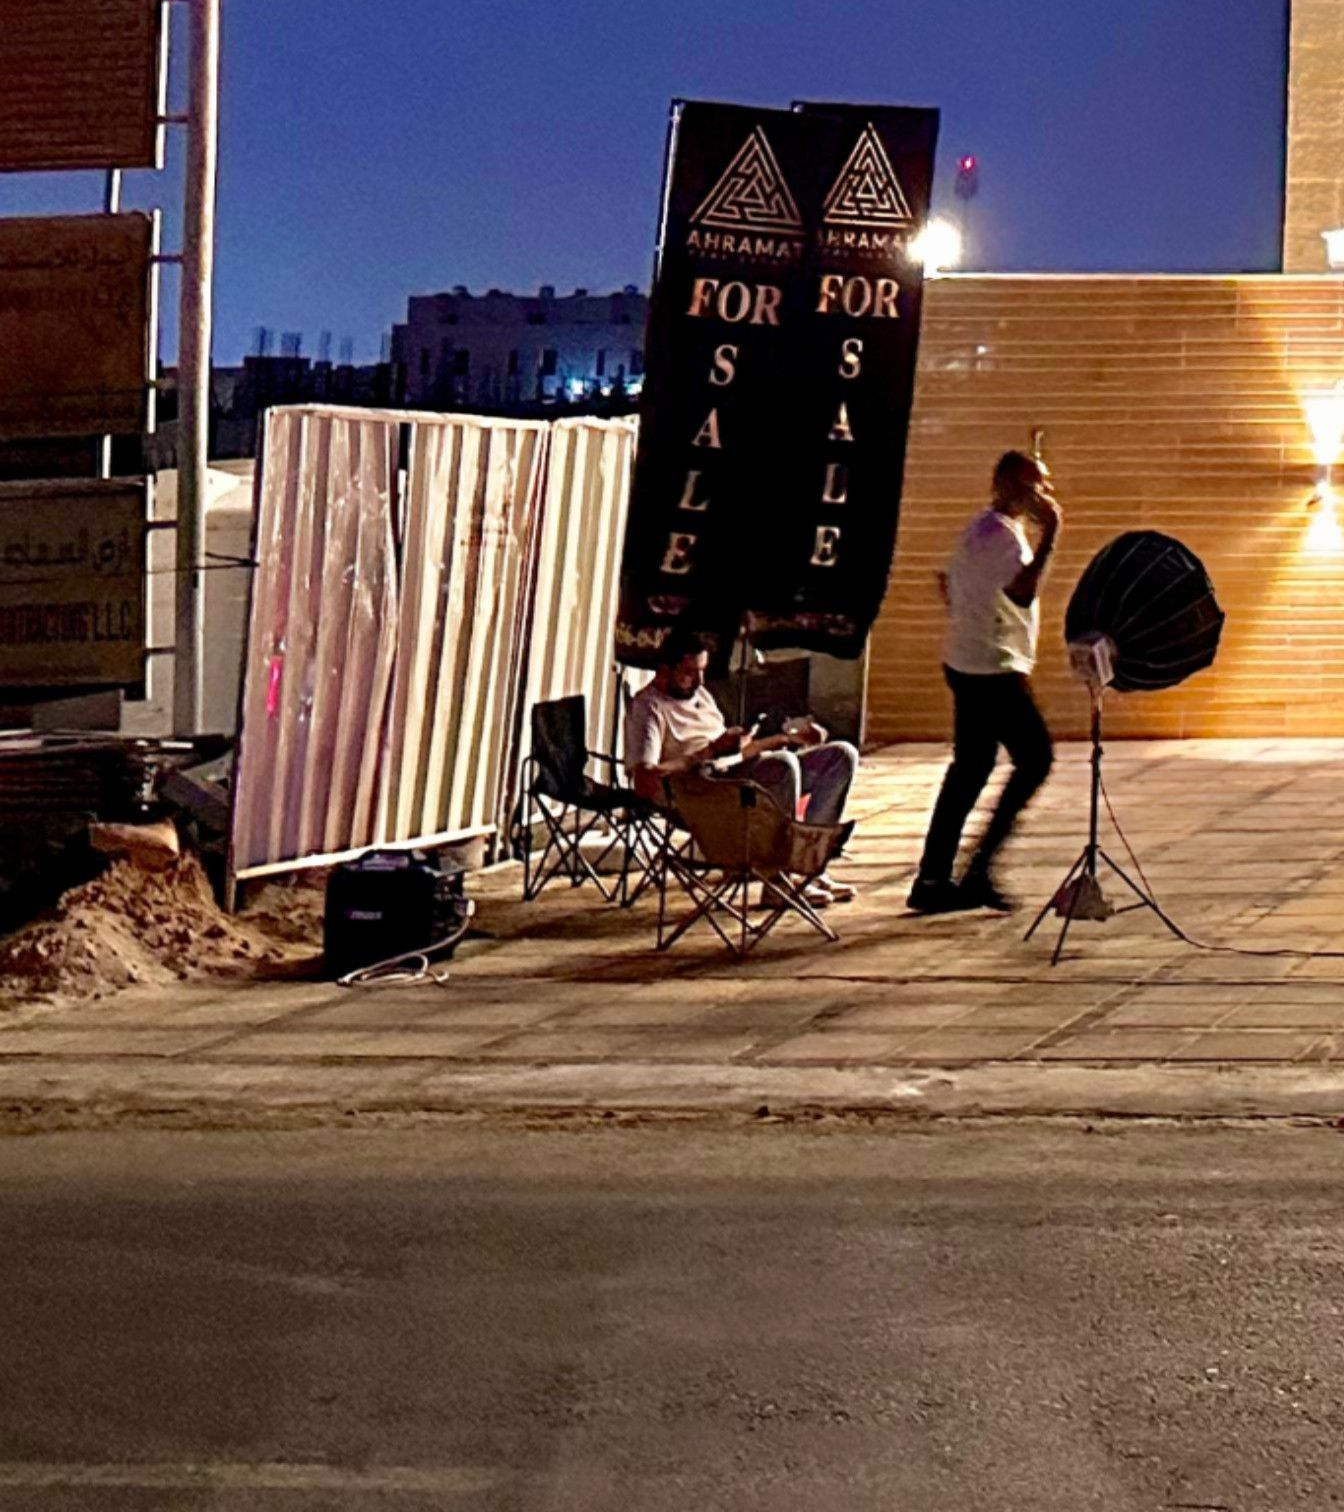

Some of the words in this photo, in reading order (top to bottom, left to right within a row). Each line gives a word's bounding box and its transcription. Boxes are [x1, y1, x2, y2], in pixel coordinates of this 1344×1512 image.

[685, 276, 783, 326] FOR
[815, 273, 900, 319] FOR
[660, 343, 740, 575] SALE
[809, 337, 864, 567] SALE
